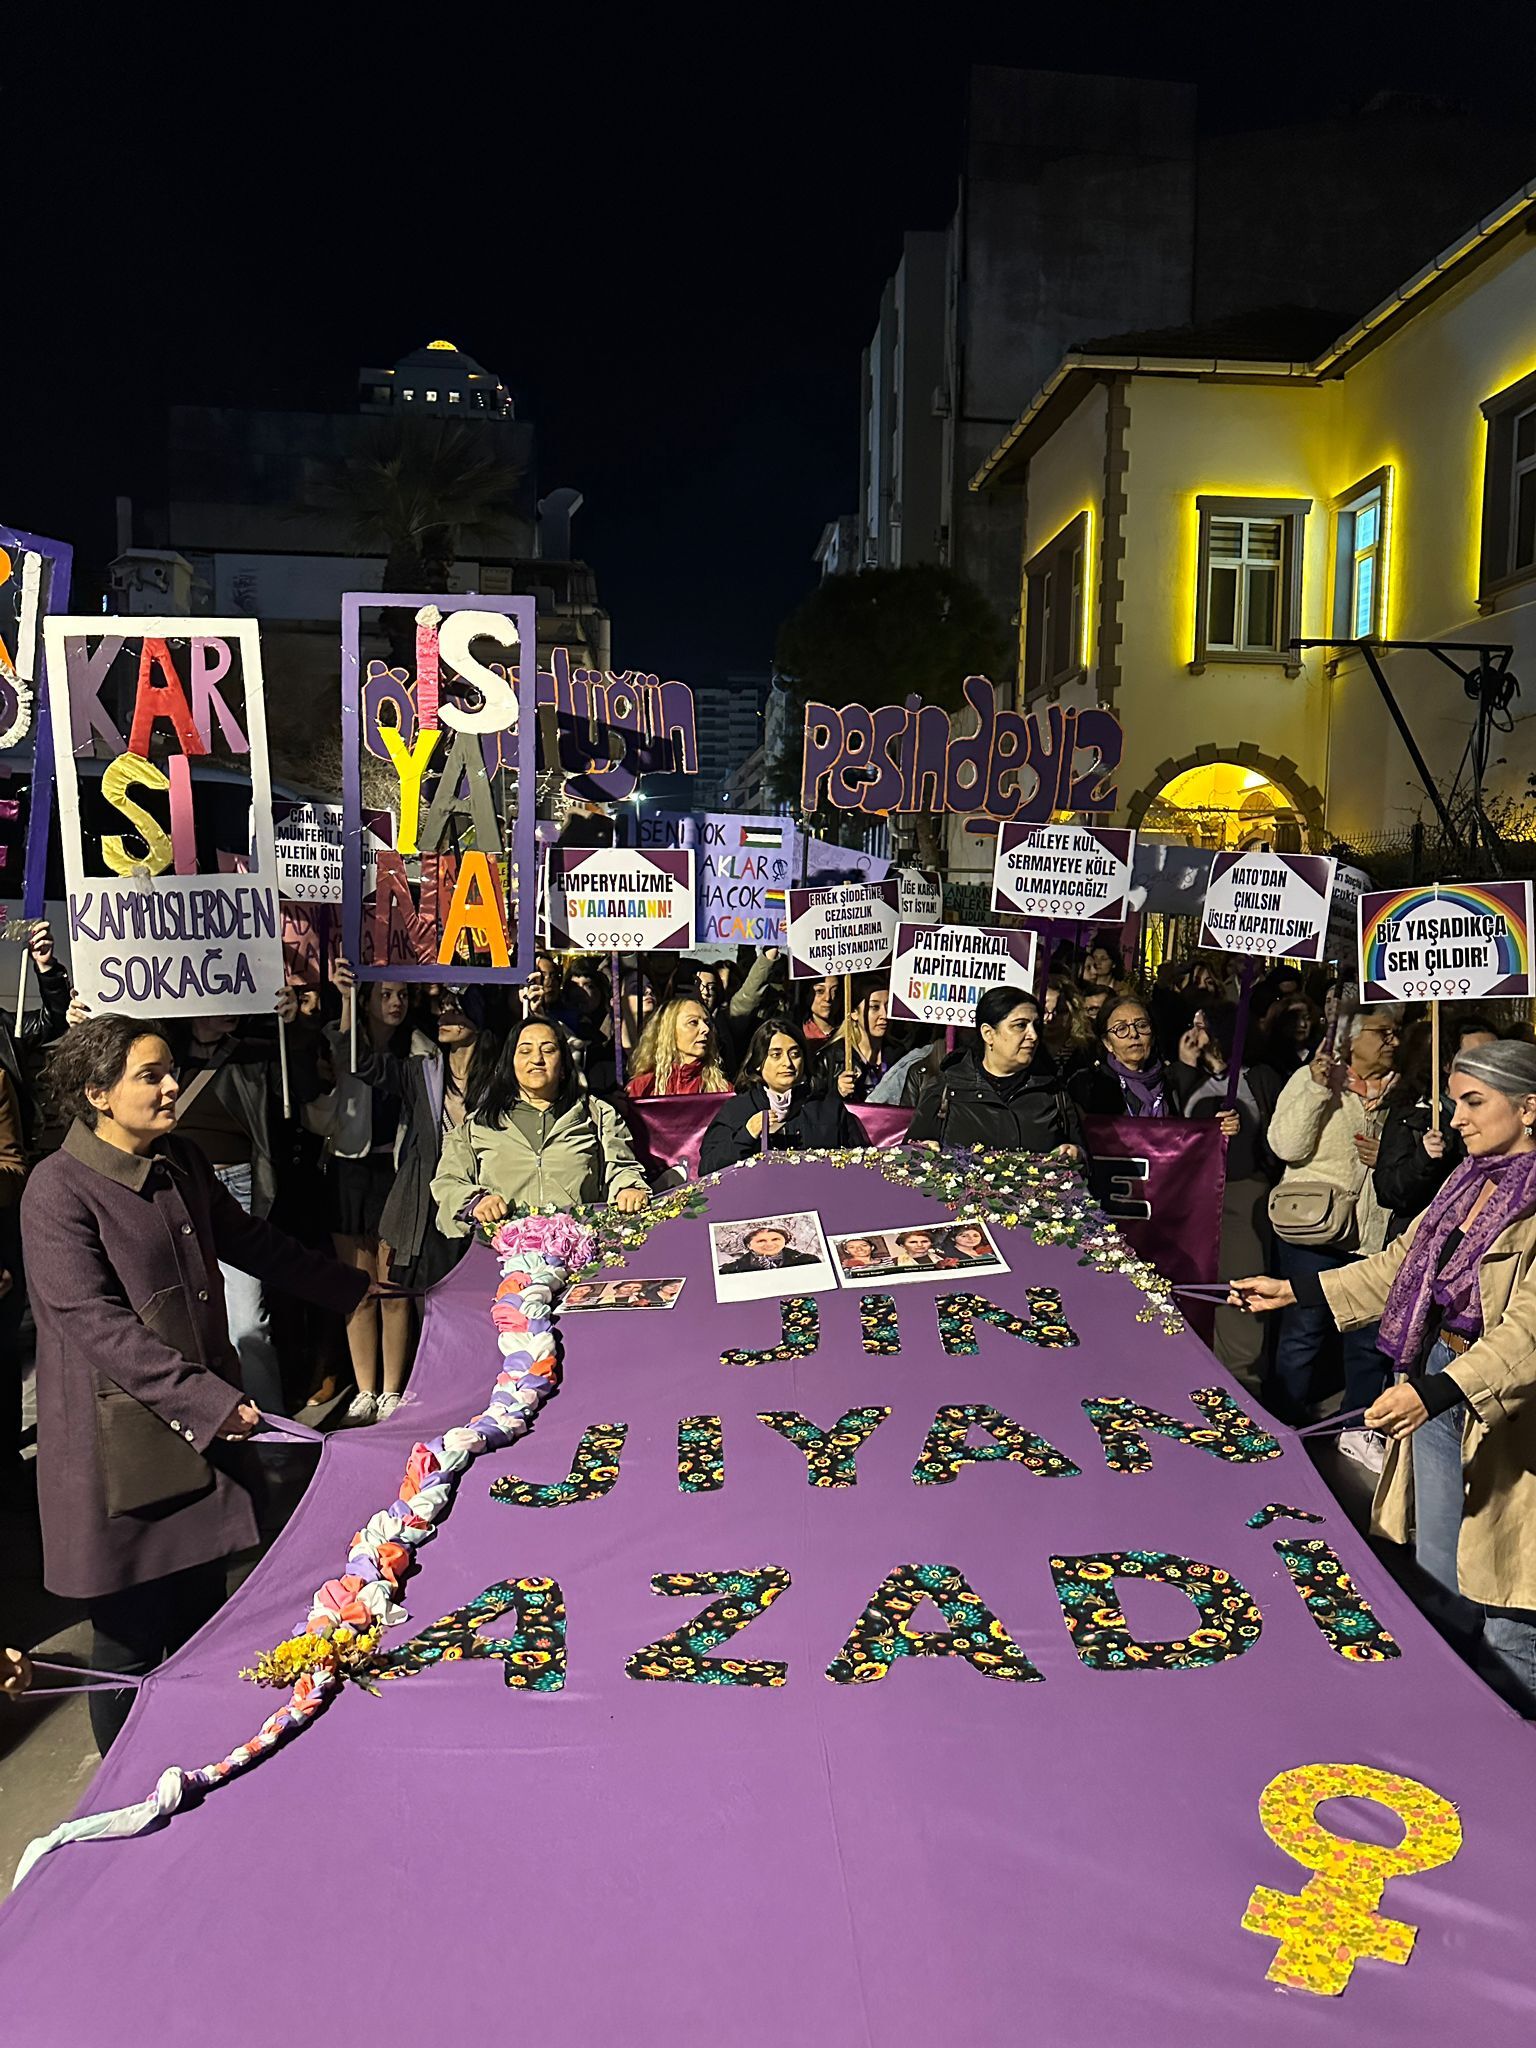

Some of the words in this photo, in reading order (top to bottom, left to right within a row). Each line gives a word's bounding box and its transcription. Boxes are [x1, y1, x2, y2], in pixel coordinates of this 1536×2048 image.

[277, 824, 335, 844] MÜNFERİT
[694, 821, 727, 847] YOK
[1027, 829, 1070, 850] AİLEYE
[1073, 834, 1100, 855] KUL,
[275, 843, 317, 861] EVLETİN
[1007, 853, 1082, 874] SERMAYEYE
[1085, 856, 1117, 876] KÖLE
[284, 863, 320, 882] ERKEK
[699, 854, 769, 880] AKLAR
[1231, 867, 1288, 888] NATO'DAN
[557, 870, 674, 892] EMPERYALİZME
[1015, 876, 1108, 899] OLMAYACAĞIZ!
[809, 892, 838, 907] ERKEK
[1234, 891, 1282, 912] ÇIKILSIN
[824, 905, 873, 922] CEZASIZLIK
[1207, 908, 1236, 930] ÜSLER
[1238, 914, 1314, 939] KAPATILSIN!
[705, 914, 781, 940] ACAKSIN
[814, 921, 883, 941] POLİTİKALARINA
[1376, 918, 1401, 944] BİZ
[1405, 914, 1508, 946] YAŞADIKÇA
[809, 945, 837, 961] KARŞI
[837, 937, 889, 957] İSYANDAYIZ!
[914, 930, 1010, 957] PATRİYARKAL
[913, 954, 1007, 982] KAPİTALİZME
[1387, 950, 1419, 972] SEN
[1424, 946, 1489, 976] ÇILDIR!
[98, 947, 257, 1003] SOKAĞA
[718, 1286, 1080, 1366] JIN
[488, 1386, 1285, 1509] JIYAN
[366, 1501, 1402, 1693] AZADÎ
